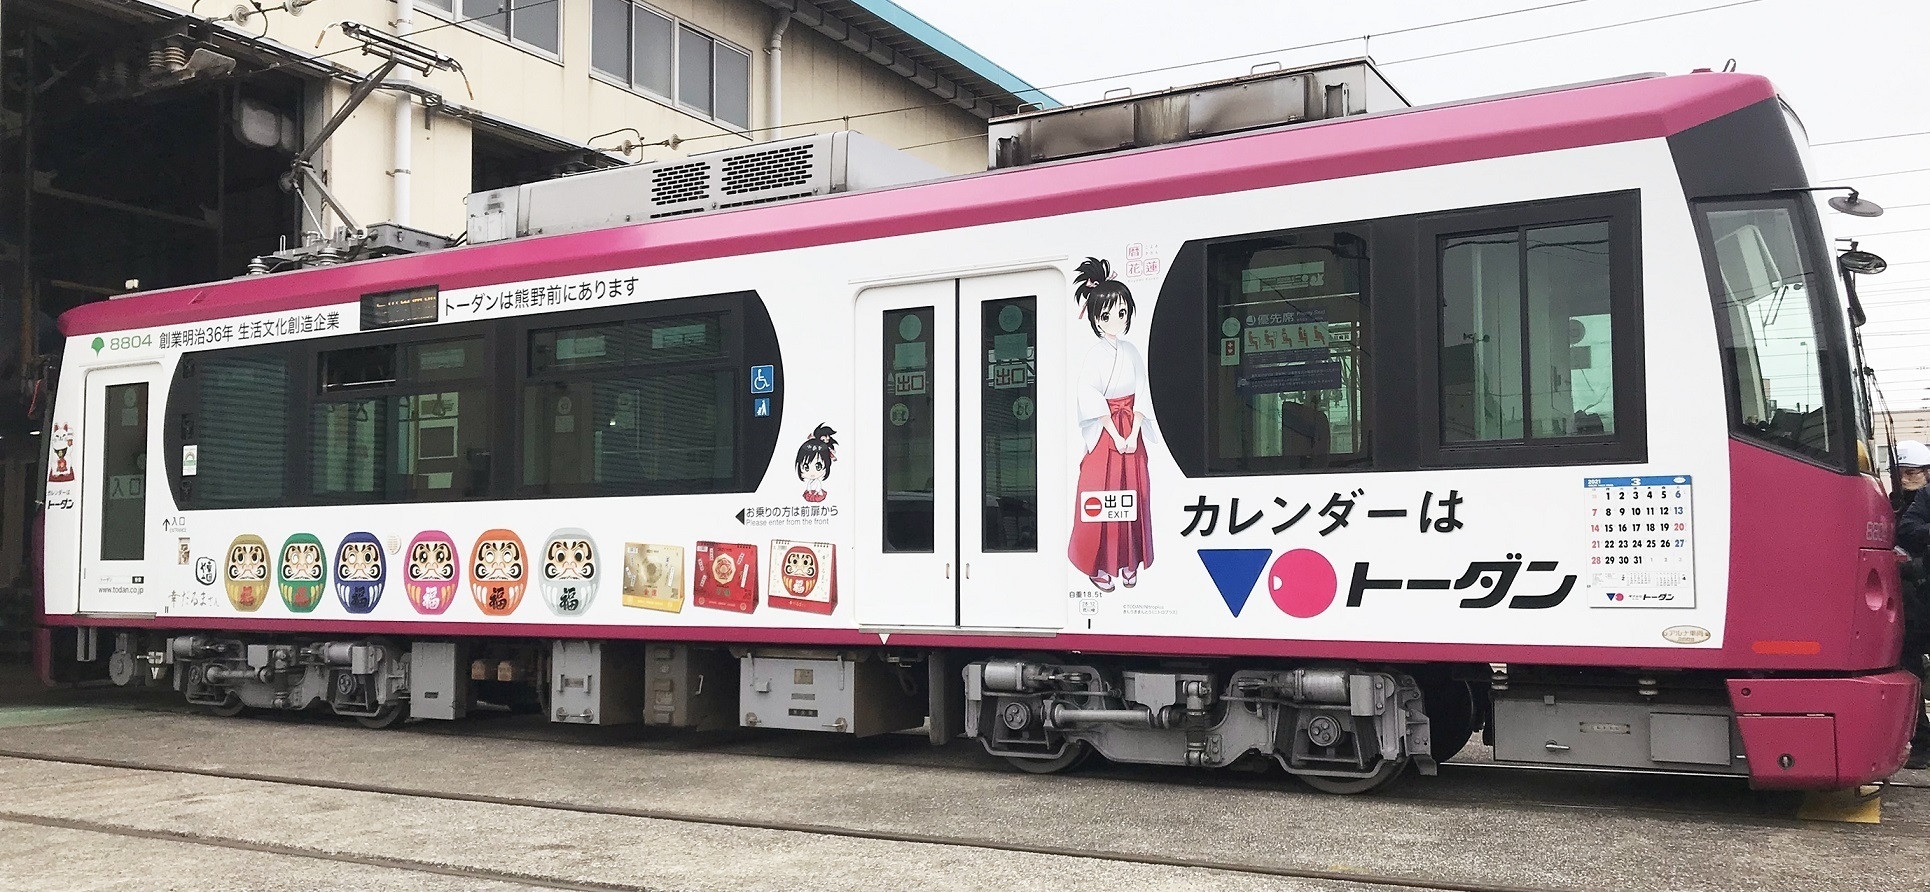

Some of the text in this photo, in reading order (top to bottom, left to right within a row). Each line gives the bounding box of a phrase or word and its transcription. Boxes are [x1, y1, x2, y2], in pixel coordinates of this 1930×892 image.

[445, 276, 639, 316] トーダンは熊野前にあります
[1258, 312, 1295, 325] 優先席
[159, 312, 340, 350] 創業明治36年 生活文化創造企業
[110, 335, 152, 350] 8804
[897, 375, 925, 392] 出口
[996, 368, 1025, 386] 出口
[112, 477, 143, 498] 入口
[1630, 477, 1642, 486] 3
[1104, 494, 1133, 508] 出口
[1606, 492, 1611, 500] 1
[1619, 492, 1625, 500] 2
[1633, 491, 1639, 499] 3
[1647, 491, 1653, 499] 4
[1661, 491, 1667, 499] 5
[1675, 490, 1681, 499] 6
[47, 498, 74, 509] トーダン
[746, 505, 839, 518] お乗りの方は前扉から
[1108, 511, 1129, 519] EXIT
[1180, 487, 1464, 537] カレンダーは
[1605, 508, 1611, 516] 8
[1619, 508, 1625, 516] 9
[1631, 507, 1641, 515] 10
[1646, 507, 1654, 515] 11
[1660, 507, 1669, 515] 12
[1674, 506, 1683, 515] 13
[171, 517, 186, 526] 入口
[1591, 523, 1684, 532] 14 15 16 17 18 19 20
[1591, 539, 1684, 549] 21 22 23 24 25 26 27
[1591, 557, 1601, 565] 28
[1605, 556, 1615, 564] 29
[1619, 556, 1629, 564] 30
[1633, 556, 1642, 564] 31
[1346, 552, 1577, 609] トーダン
[98, 586, 144, 595] www.todan.co.jp
[422, 587, 440, 609] 福
[489, 587, 506, 609] 福
[559, 587, 579, 610] 福
